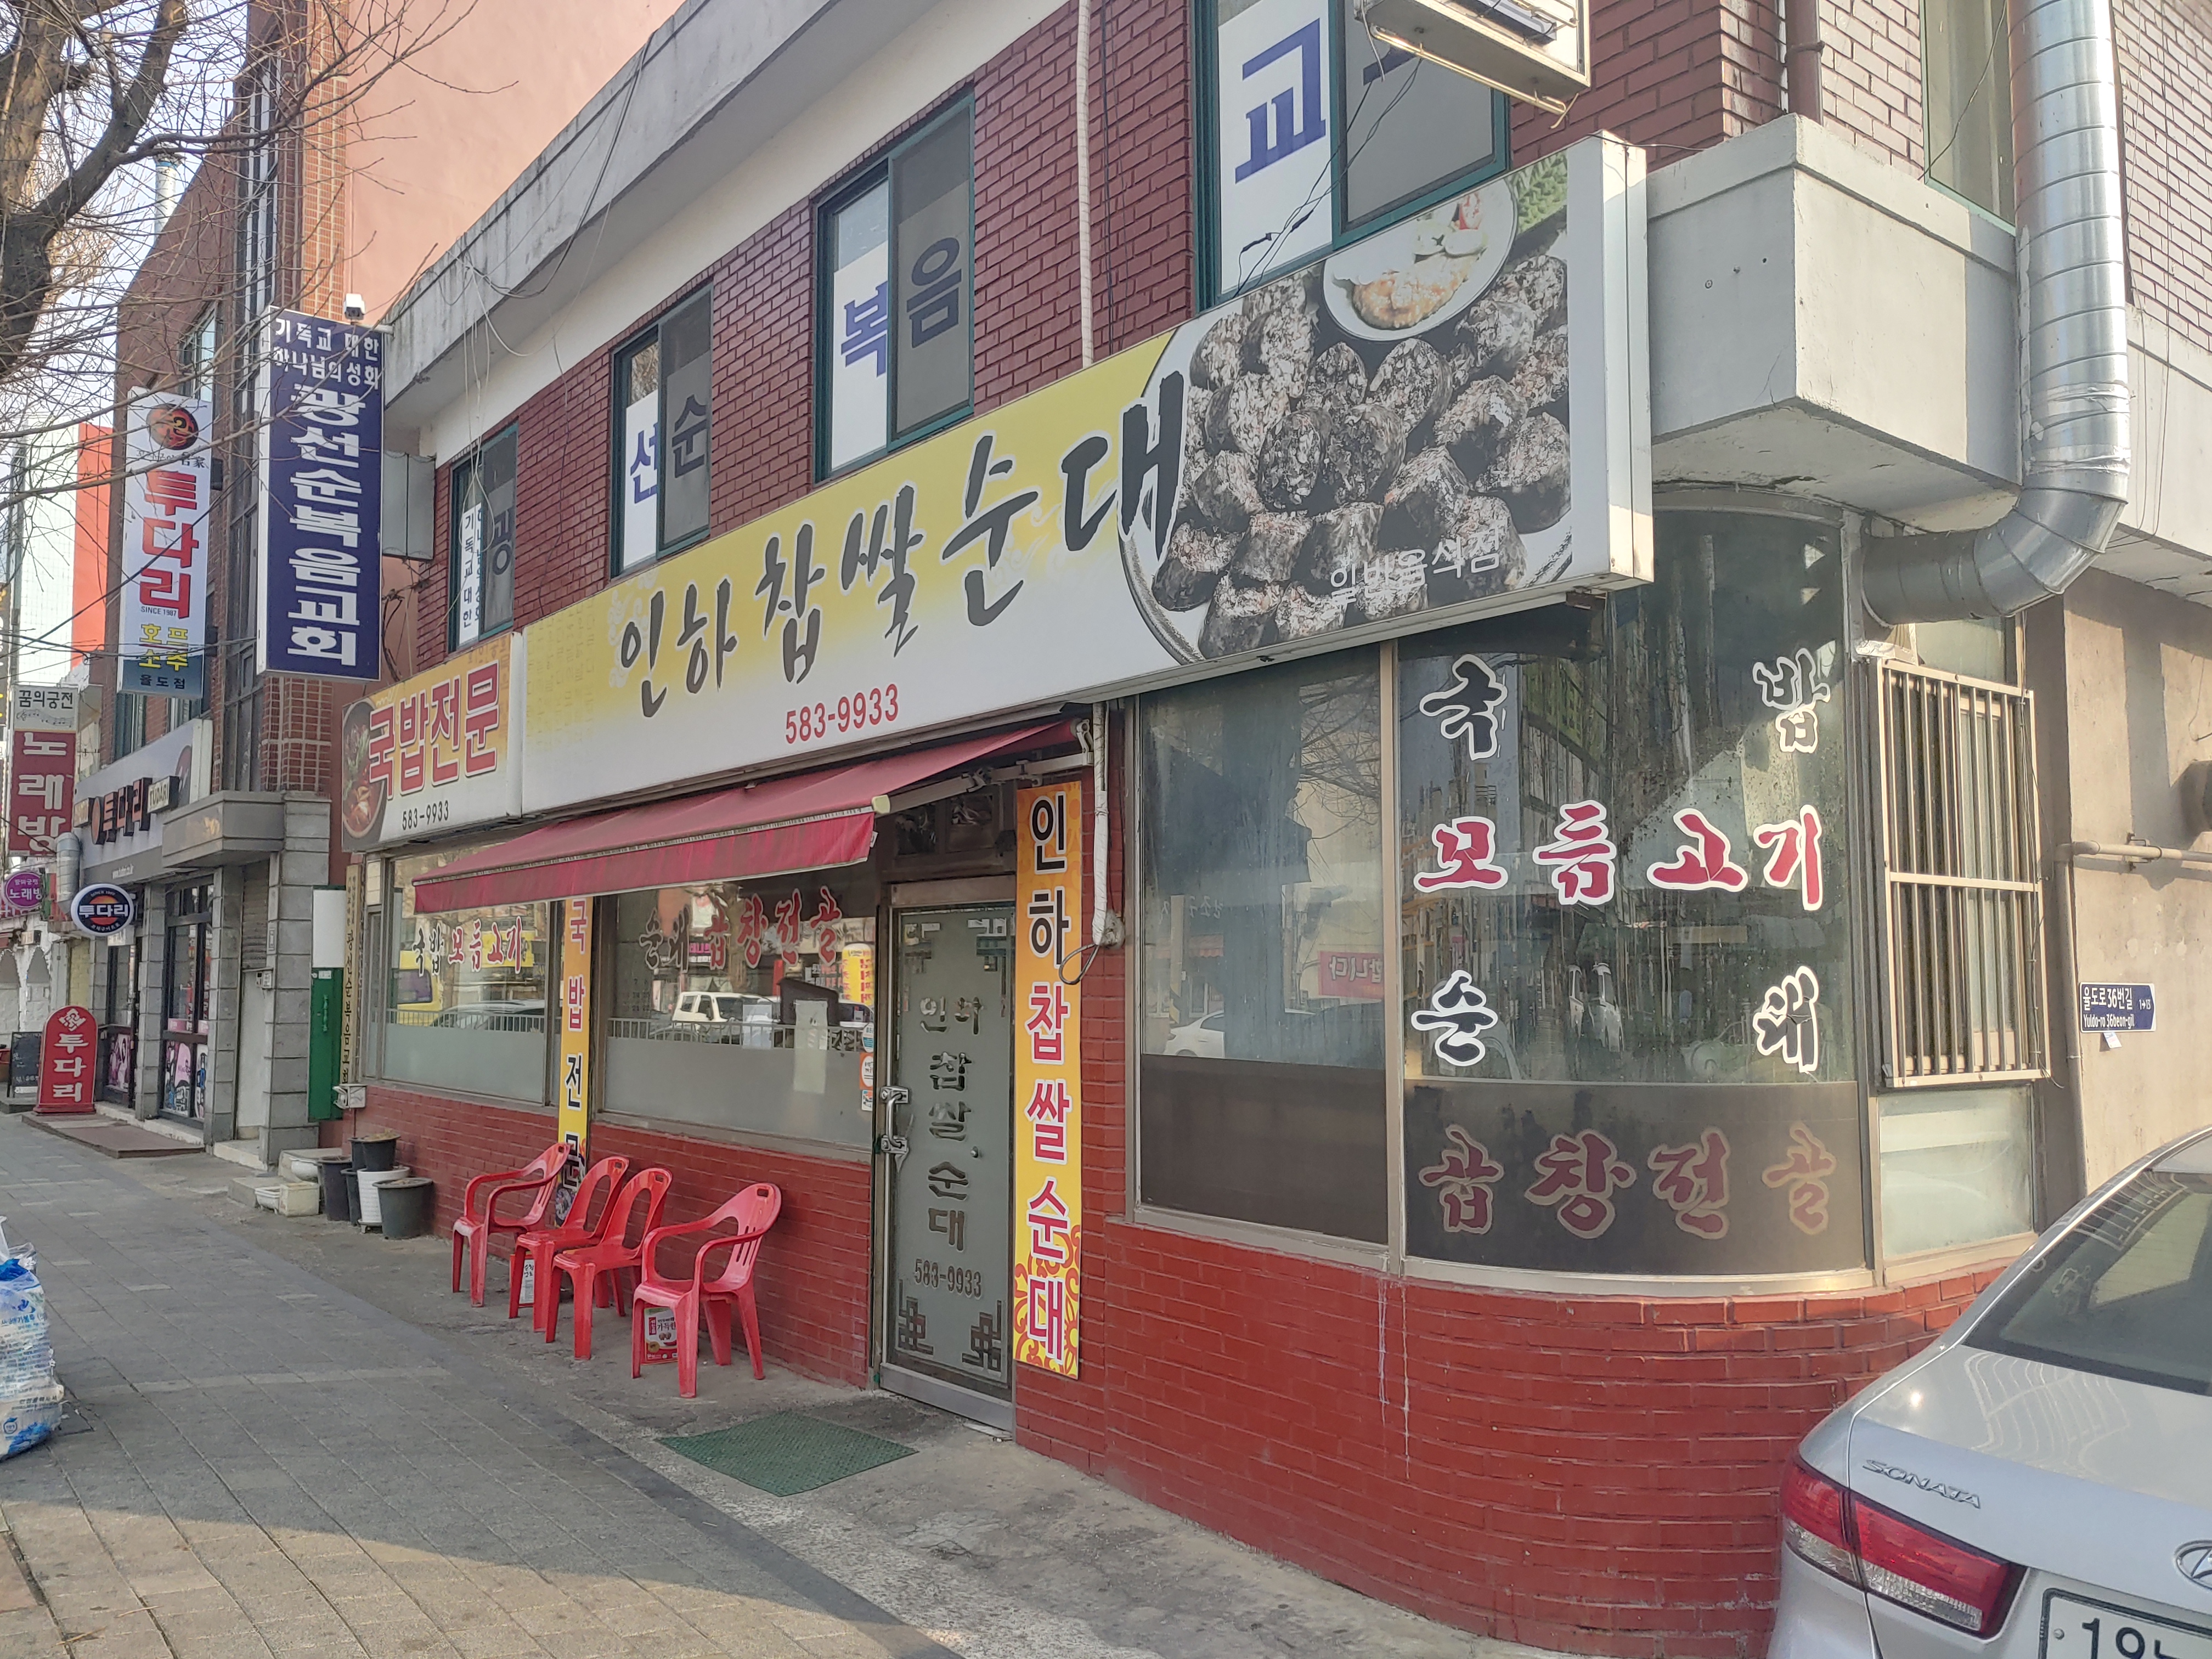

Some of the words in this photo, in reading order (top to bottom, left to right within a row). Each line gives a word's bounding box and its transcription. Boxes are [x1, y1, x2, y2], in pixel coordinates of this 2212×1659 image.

[275, 318, 332, 351] 기독교
[287, 383, 366, 666] 광선순복음교회
[139, 470, 199, 619] 투다리
[1330, 526, 1502, 605] 일반음식점
[141, 606, 161, 614] SINCE
[139, 624, 189, 647] 호프
[139, 649, 188, 671] 소주
[140, 674, 185, 690] 율도점
[19, 689, 74, 709] 꿈의궁전
[785, 683, 899, 745] 583-9933
[369, 659, 499, 800] 국밥전문
[18, 732, 67, 853] 노래방
[402, 800, 449, 831] 583-9933
[79, 904, 128, 918] 투다리
[2083, 986, 2133, 1011] 율도로36번길
[2084, 1014, 2106, 1028] Yuldo-ro
[2106, 1013, 2135, 1029] 36beon-gil
[53, 1034, 89, 1102] 투다리
[915, 1258, 983, 1299] 583-9933
[1862, 1459, 1982, 1509] SONATA
